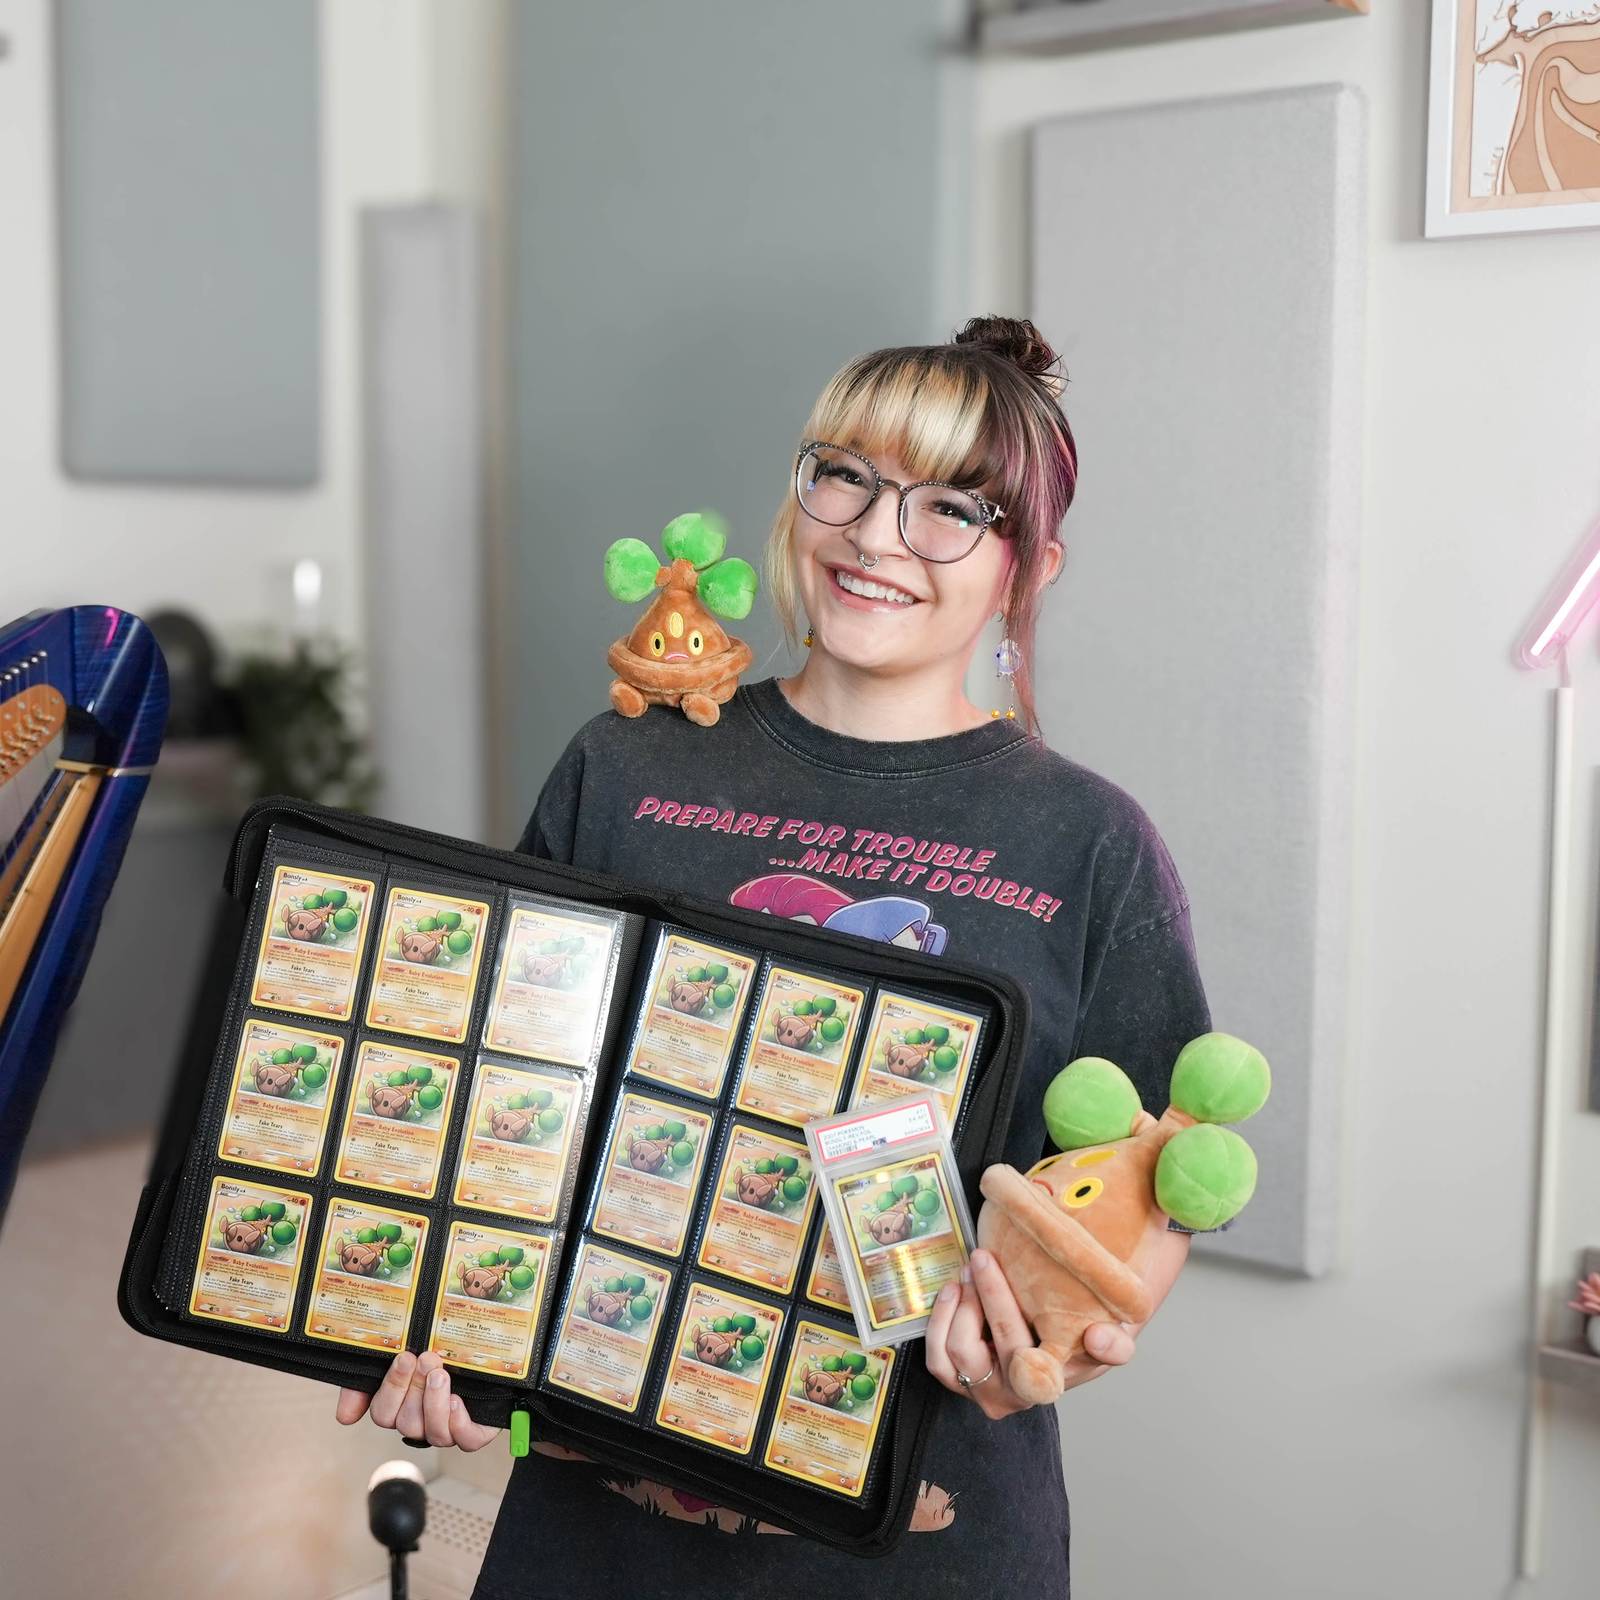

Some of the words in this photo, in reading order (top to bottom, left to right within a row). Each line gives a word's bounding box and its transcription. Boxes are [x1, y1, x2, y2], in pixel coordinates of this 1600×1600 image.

[634, 796, 780, 838] PREPARE
[777, 819, 848, 848] FOR
[851, 827, 997, 873] TROUBLE
[282, 872, 301, 881] Bonsly
[769, 847, 889, 881] ...MAKE
[889, 863, 926, 885] IT
[924, 868, 1063, 924] DOUBLE!
[396, 894, 416, 903] Bonsly
[252, 1025, 271, 1035] Bonsly
[367, 1047, 386, 1057] Bonsly
[220, 1183, 239, 1193] Bonsly
[336, 1204, 356, 1214] Bonsly
[457, 1228, 477, 1238] Bonsly
[695, 1290, 714, 1302] Bonsly
[804, 1328, 823, 1340] Bonsly
[695, 1388, 706, 1396] Fake
[707, 1392, 719, 1400] Tears
[805, 1428, 816, 1436] Fake
[816, 1432, 829, 1441] Tears
